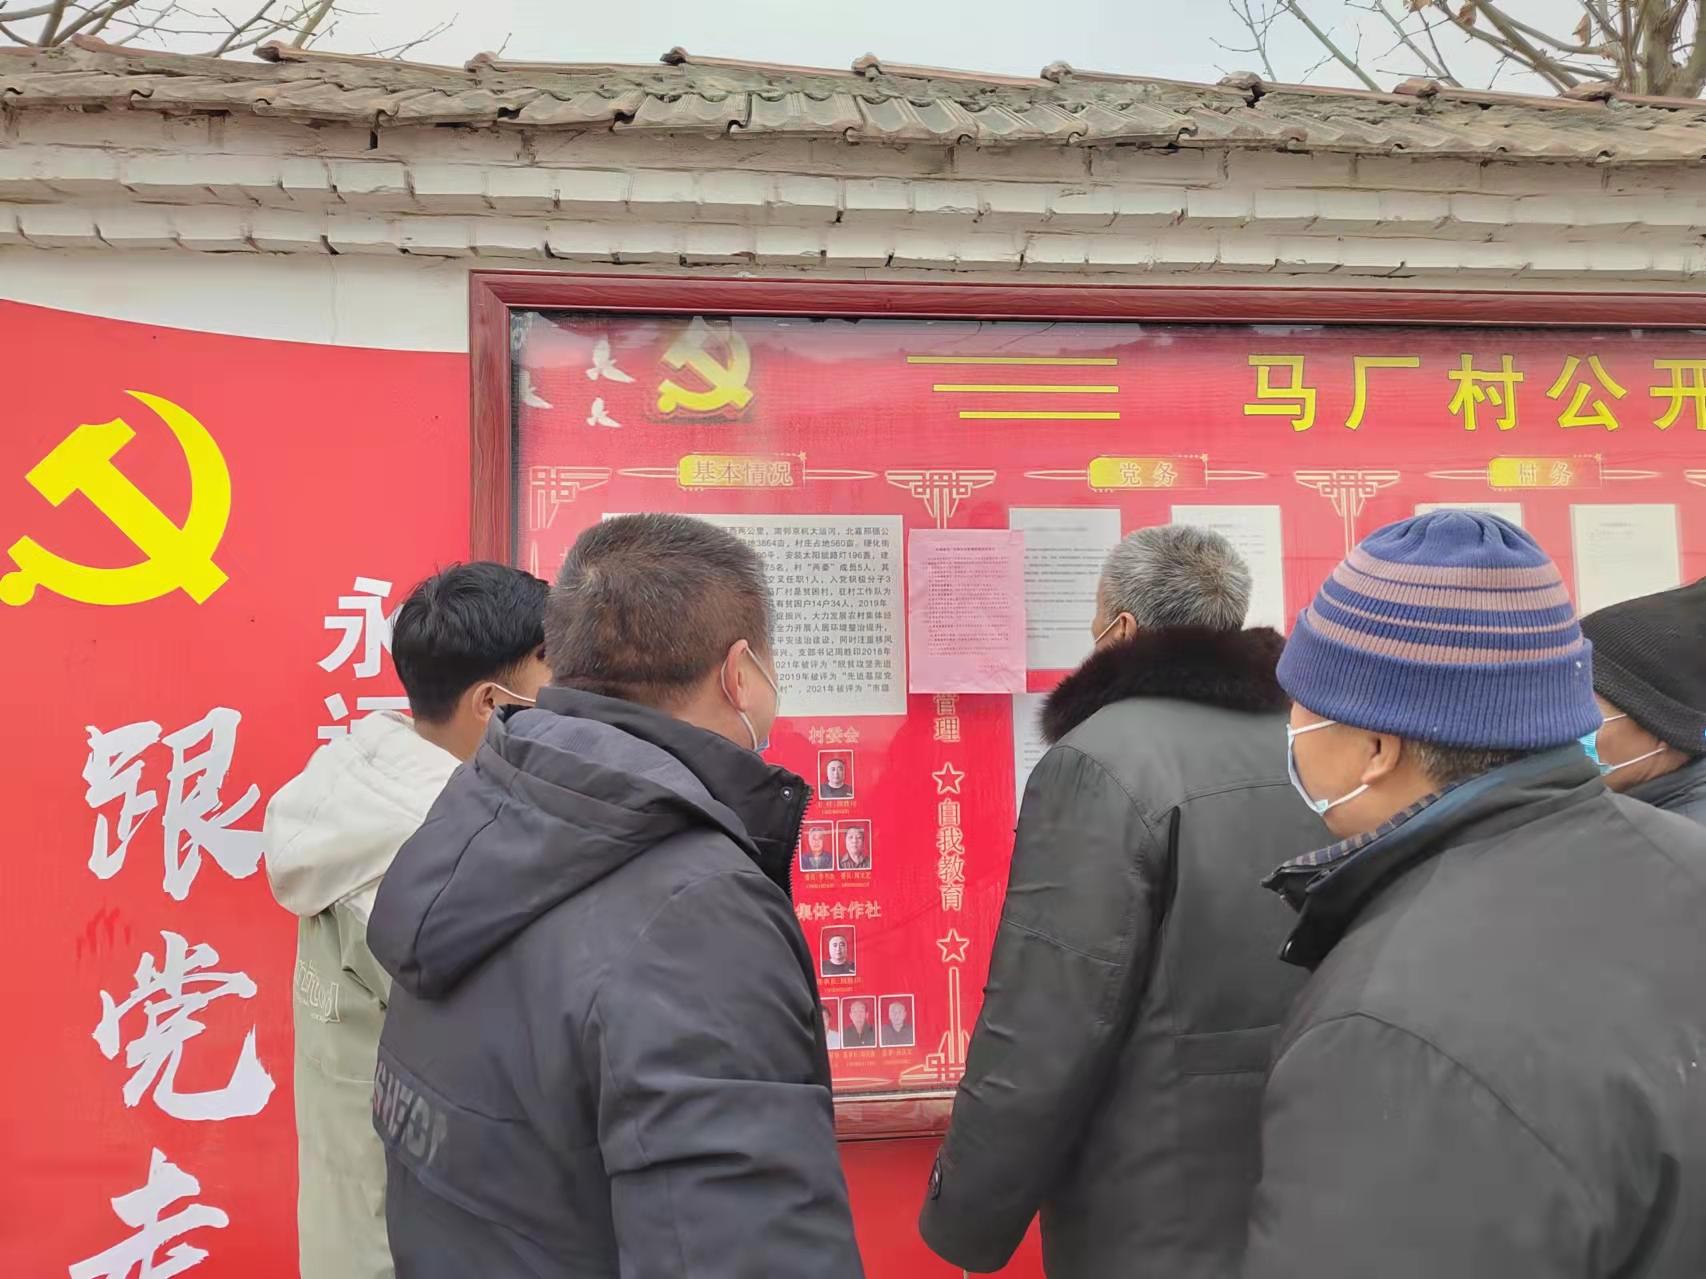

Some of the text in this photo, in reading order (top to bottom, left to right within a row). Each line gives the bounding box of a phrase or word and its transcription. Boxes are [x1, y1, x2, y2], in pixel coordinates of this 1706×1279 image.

[1243, 354, 1706, 432] 马厂村公开
[692, 460, 794, 487] 基本情况
[1119, 461, 1179, 487] 党务
[936, 798, 966, 912] 自我教育
